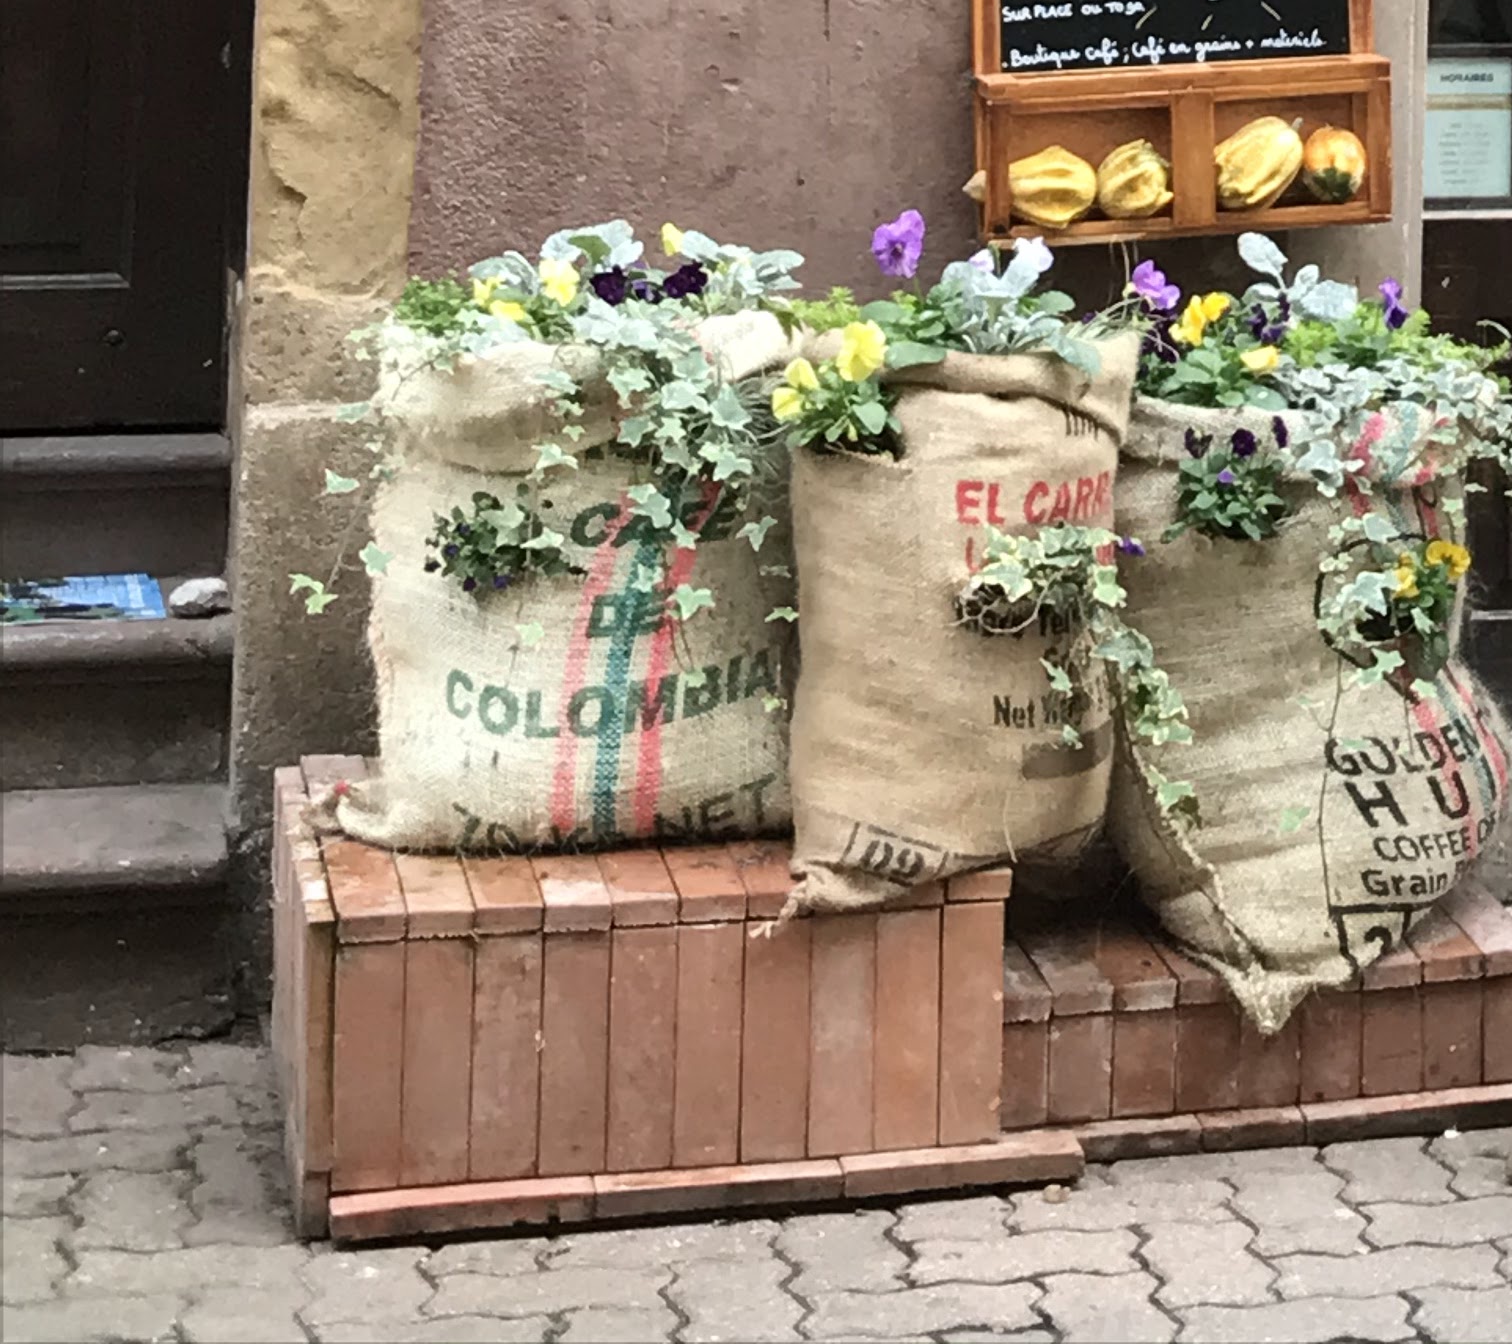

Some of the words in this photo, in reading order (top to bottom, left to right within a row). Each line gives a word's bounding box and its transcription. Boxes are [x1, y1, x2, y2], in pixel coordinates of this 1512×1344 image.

[956, 479, 1005, 526] EL
[587, 593, 666, 639] DE
[446, 648, 781, 739] COLOMBIA
[994, 695, 1034, 730] Net
[1373, 824, 1473, 863] COFFEE
